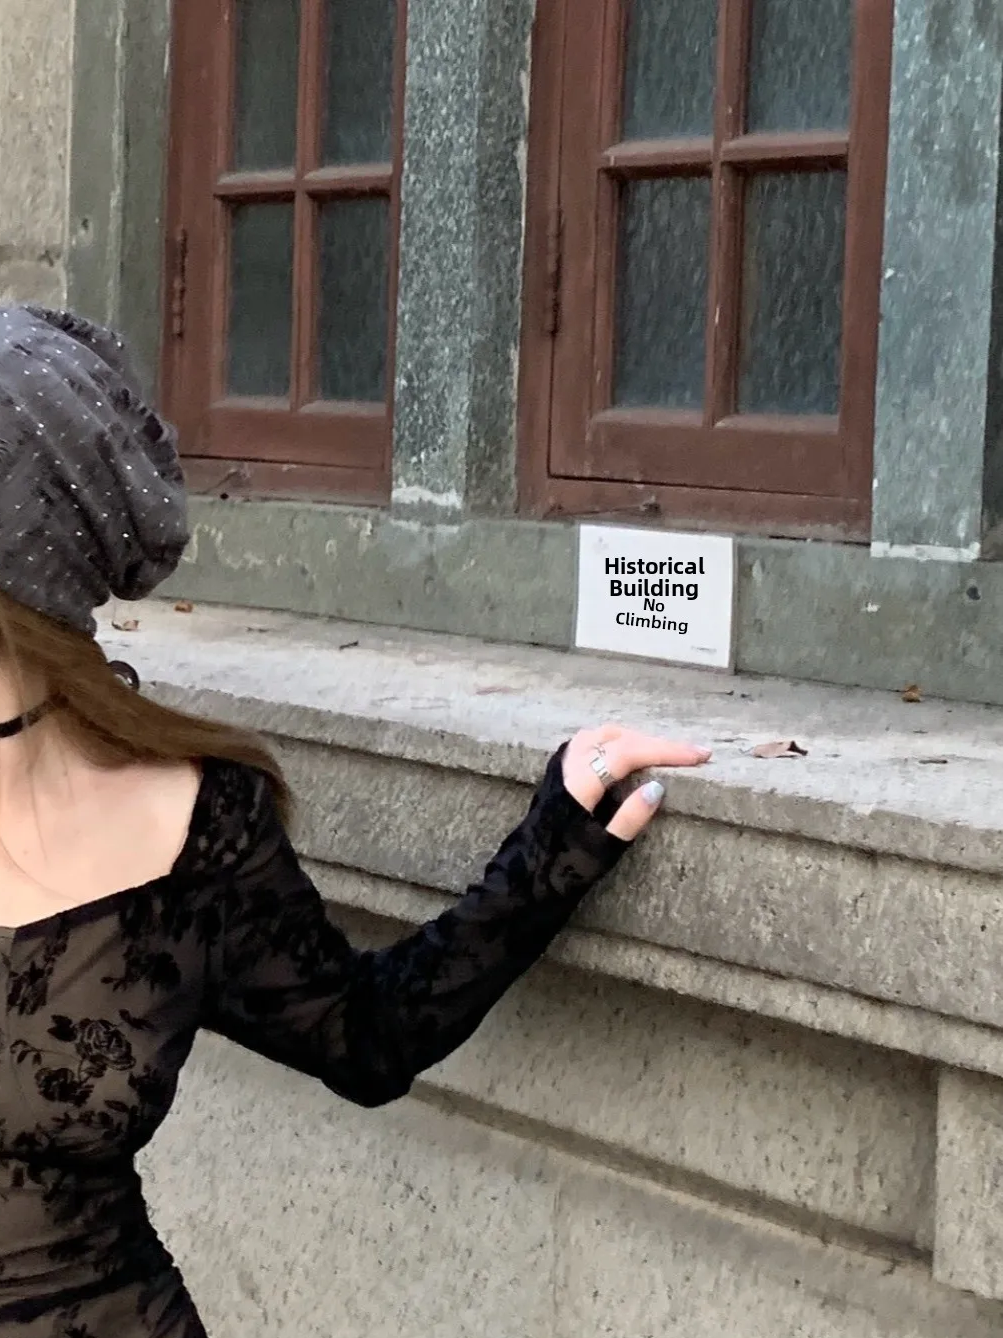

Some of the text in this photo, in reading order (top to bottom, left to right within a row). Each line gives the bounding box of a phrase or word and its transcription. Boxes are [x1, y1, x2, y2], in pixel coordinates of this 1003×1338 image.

[605, 556, 705, 575] Historical
[610, 579, 699, 601] Building
[643, 598, 665, 612] No
[616, 612, 688, 635] Climbing
